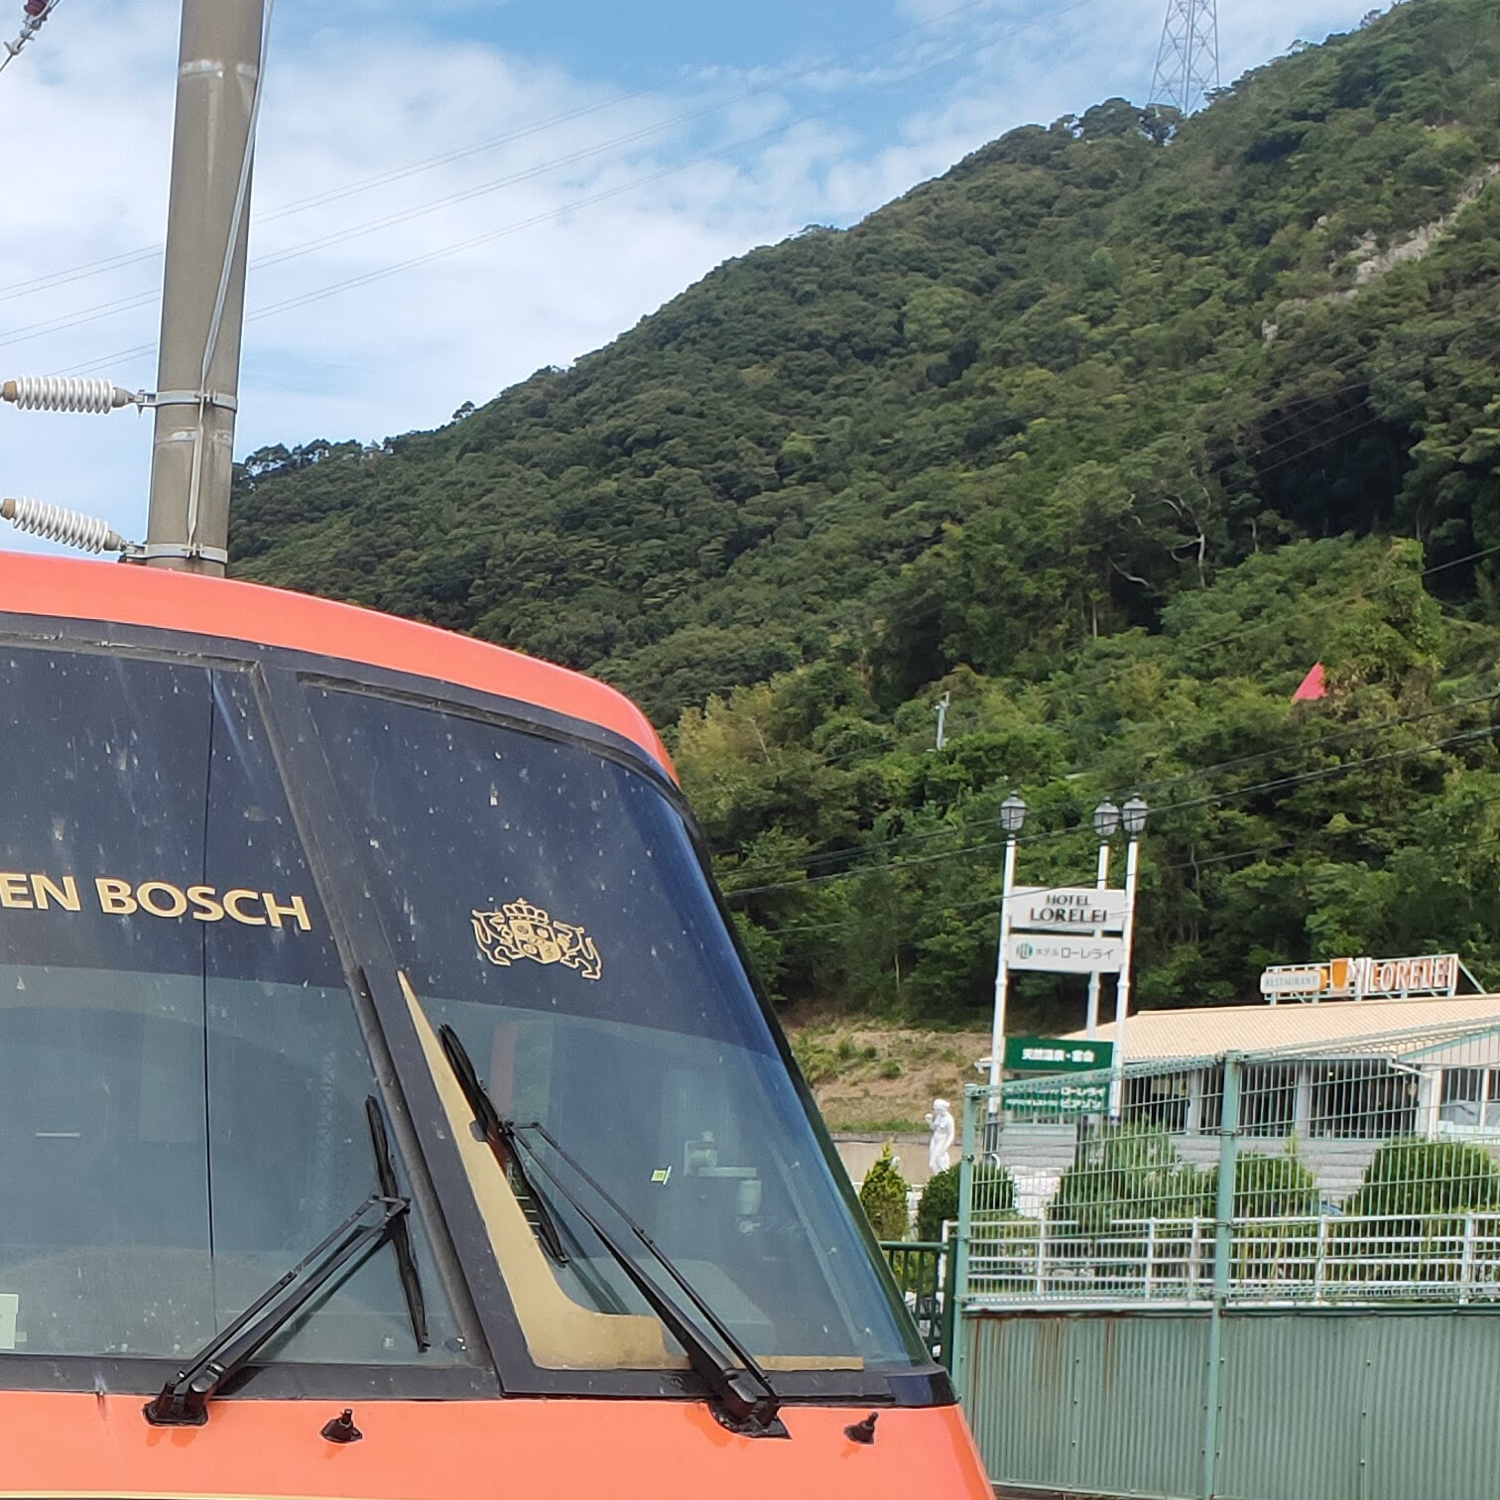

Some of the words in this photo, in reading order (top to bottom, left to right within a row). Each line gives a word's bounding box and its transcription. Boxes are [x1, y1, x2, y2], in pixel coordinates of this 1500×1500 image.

[95, 877, 313, 931] BOSCH
[1046, 894, 1091, 906] HOTEL
[1030, 907, 1108, 923] LORELEI
[1265, 976, 1318, 988] RESTAURANT
[1368, 956, 1455, 992] LORELEI
